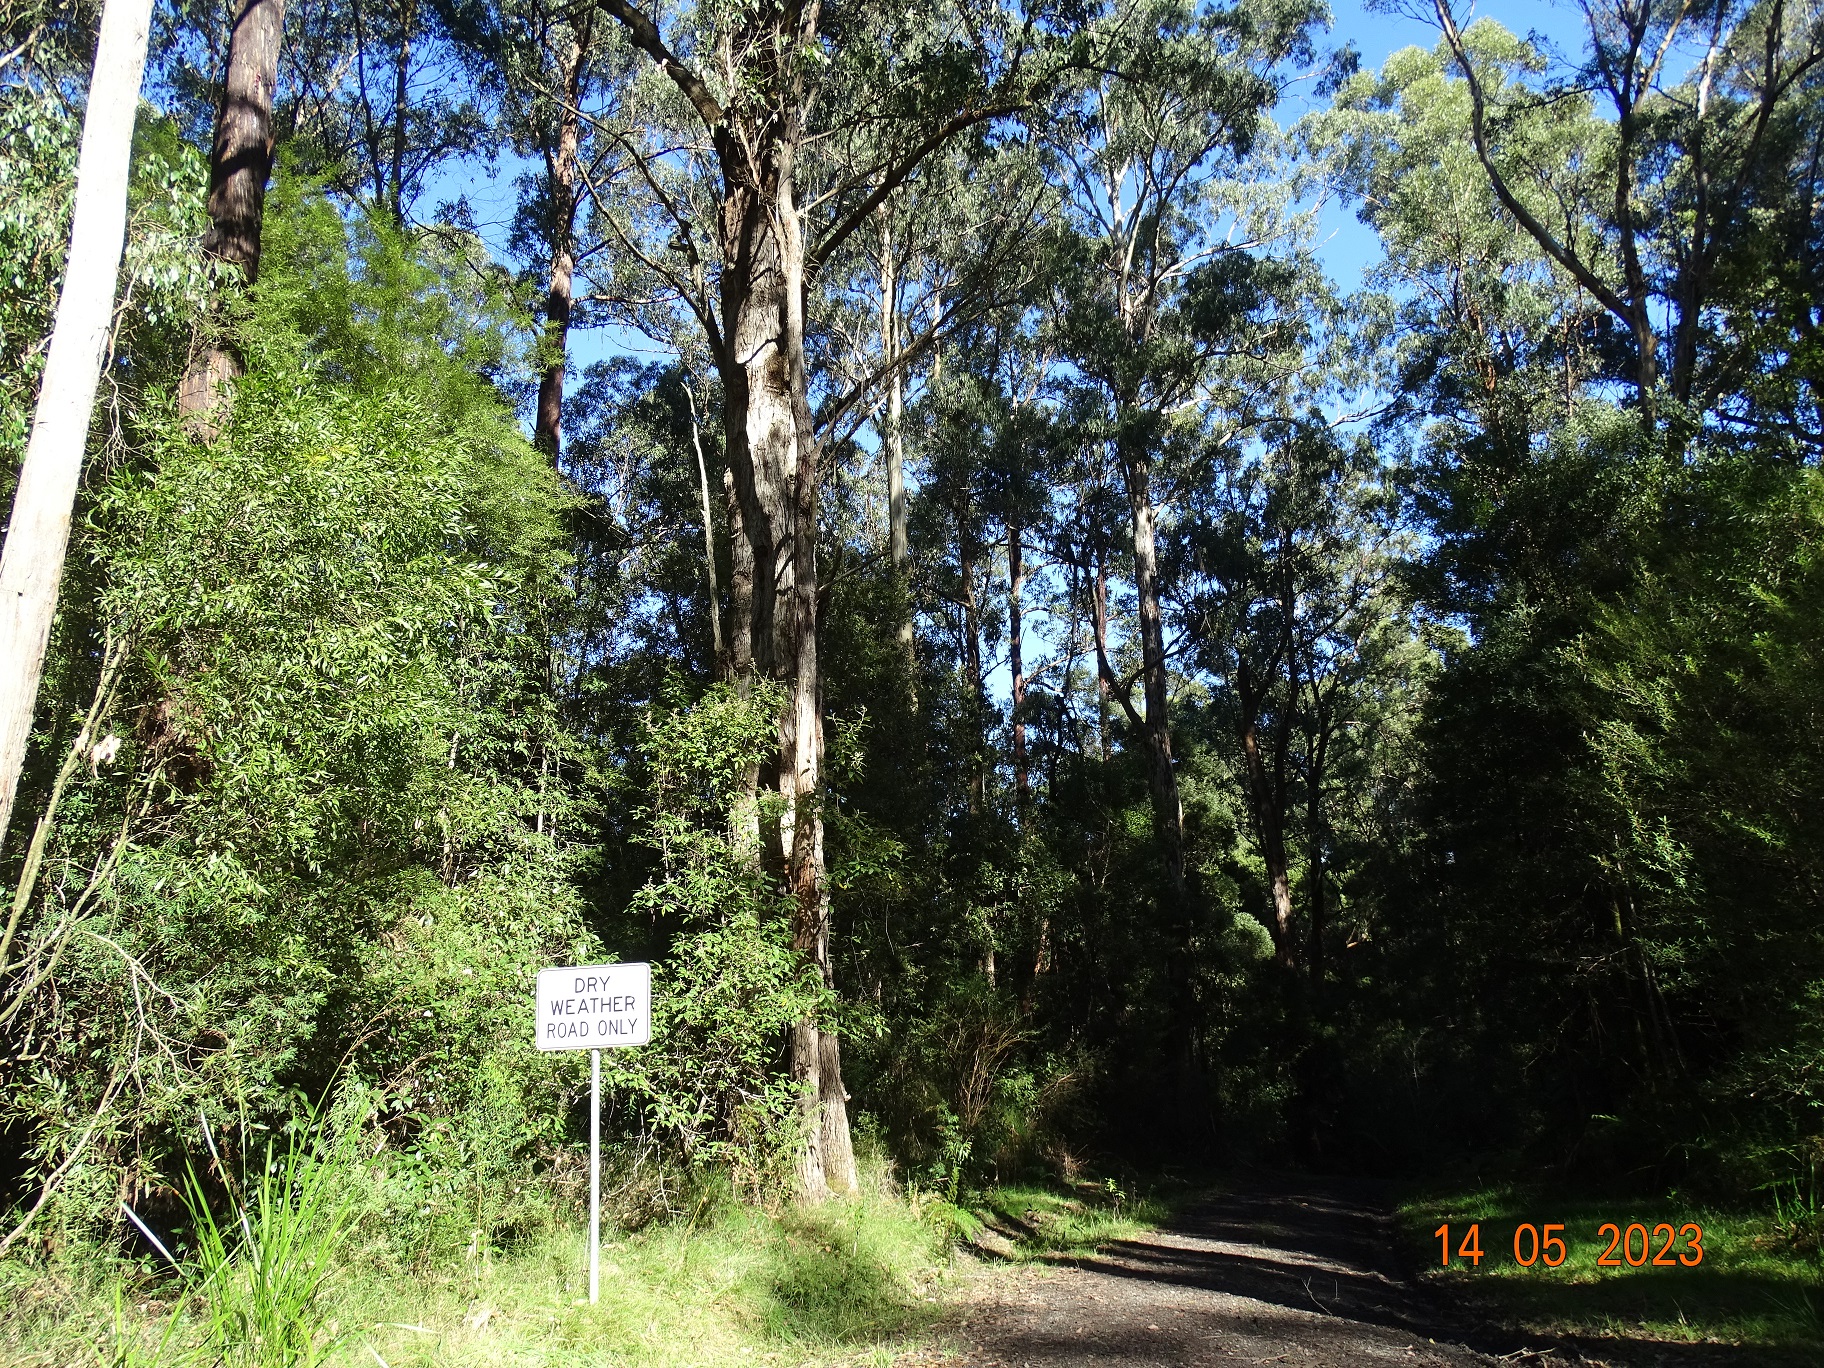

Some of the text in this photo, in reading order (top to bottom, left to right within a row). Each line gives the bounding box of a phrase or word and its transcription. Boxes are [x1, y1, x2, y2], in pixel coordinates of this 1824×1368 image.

[574, 975, 611, 994] DRY
[550, 995, 636, 1016] WEATHER
[546, 1018, 638, 1039] ROAD ONLY
